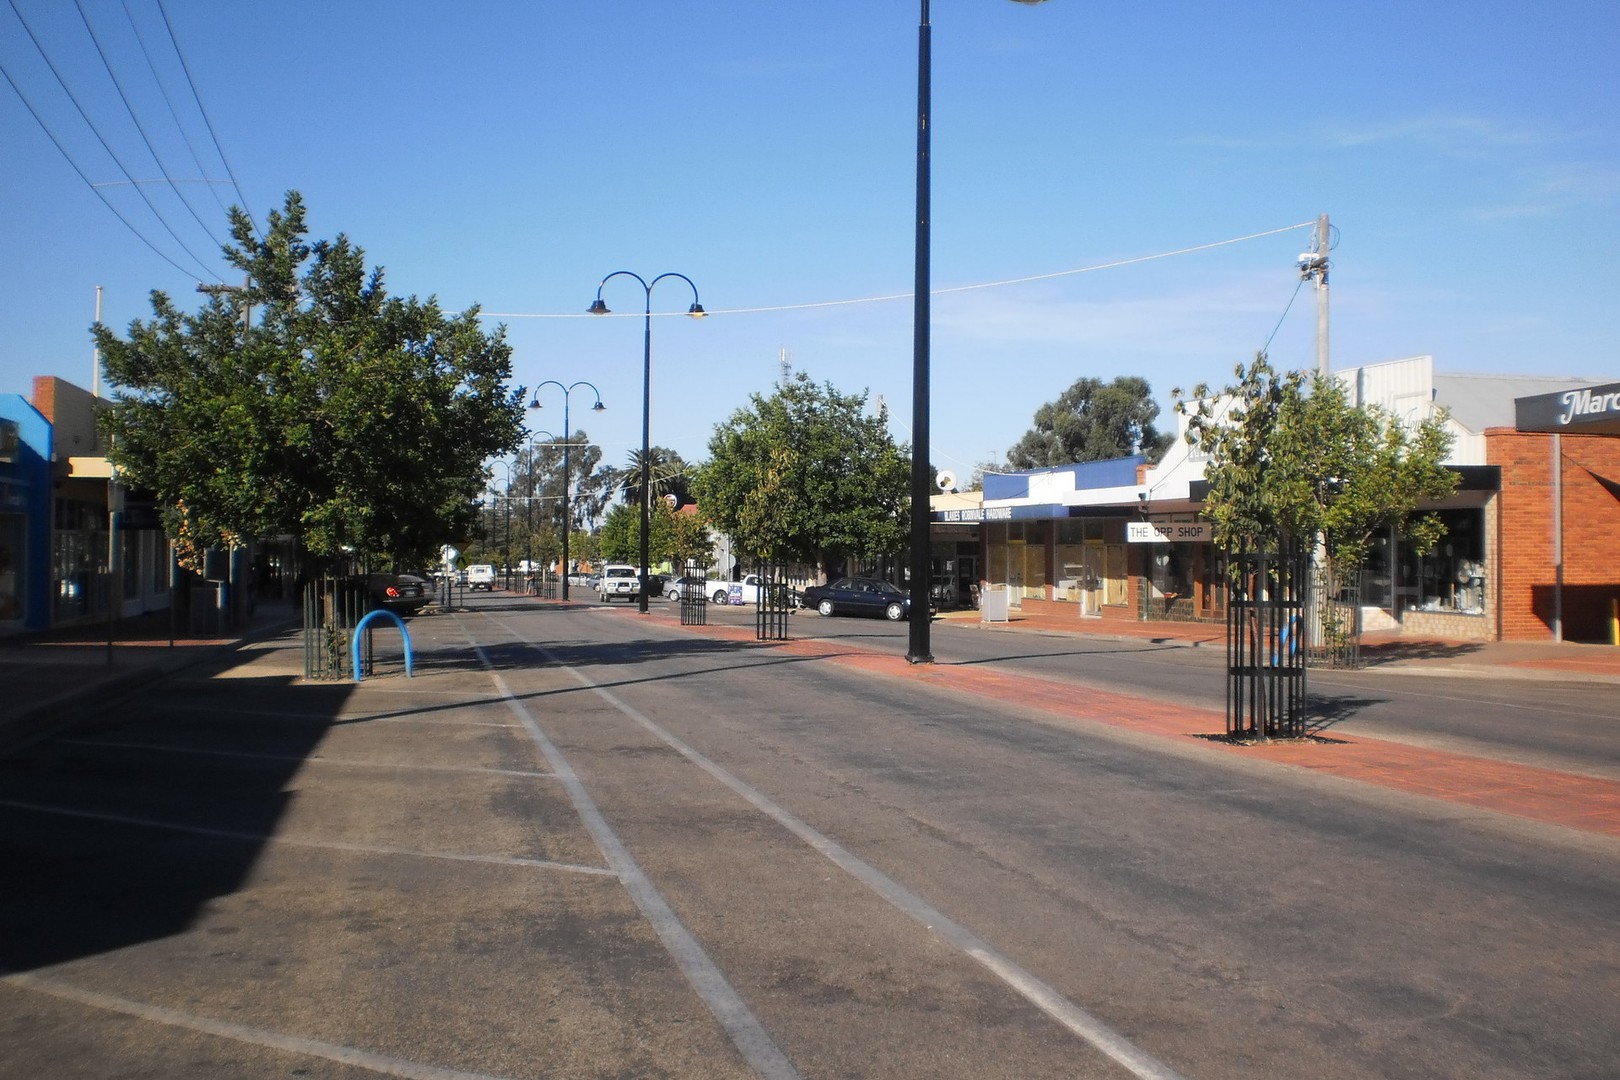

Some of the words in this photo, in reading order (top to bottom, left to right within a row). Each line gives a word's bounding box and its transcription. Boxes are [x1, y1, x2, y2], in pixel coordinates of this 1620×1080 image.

[986, 507, 1012, 519] HARDWARE
[1130, 527, 1149, 537] THE
[1154, 527, 1173, 537] OPP
[1178, 527, 1203, 537] SHOP
